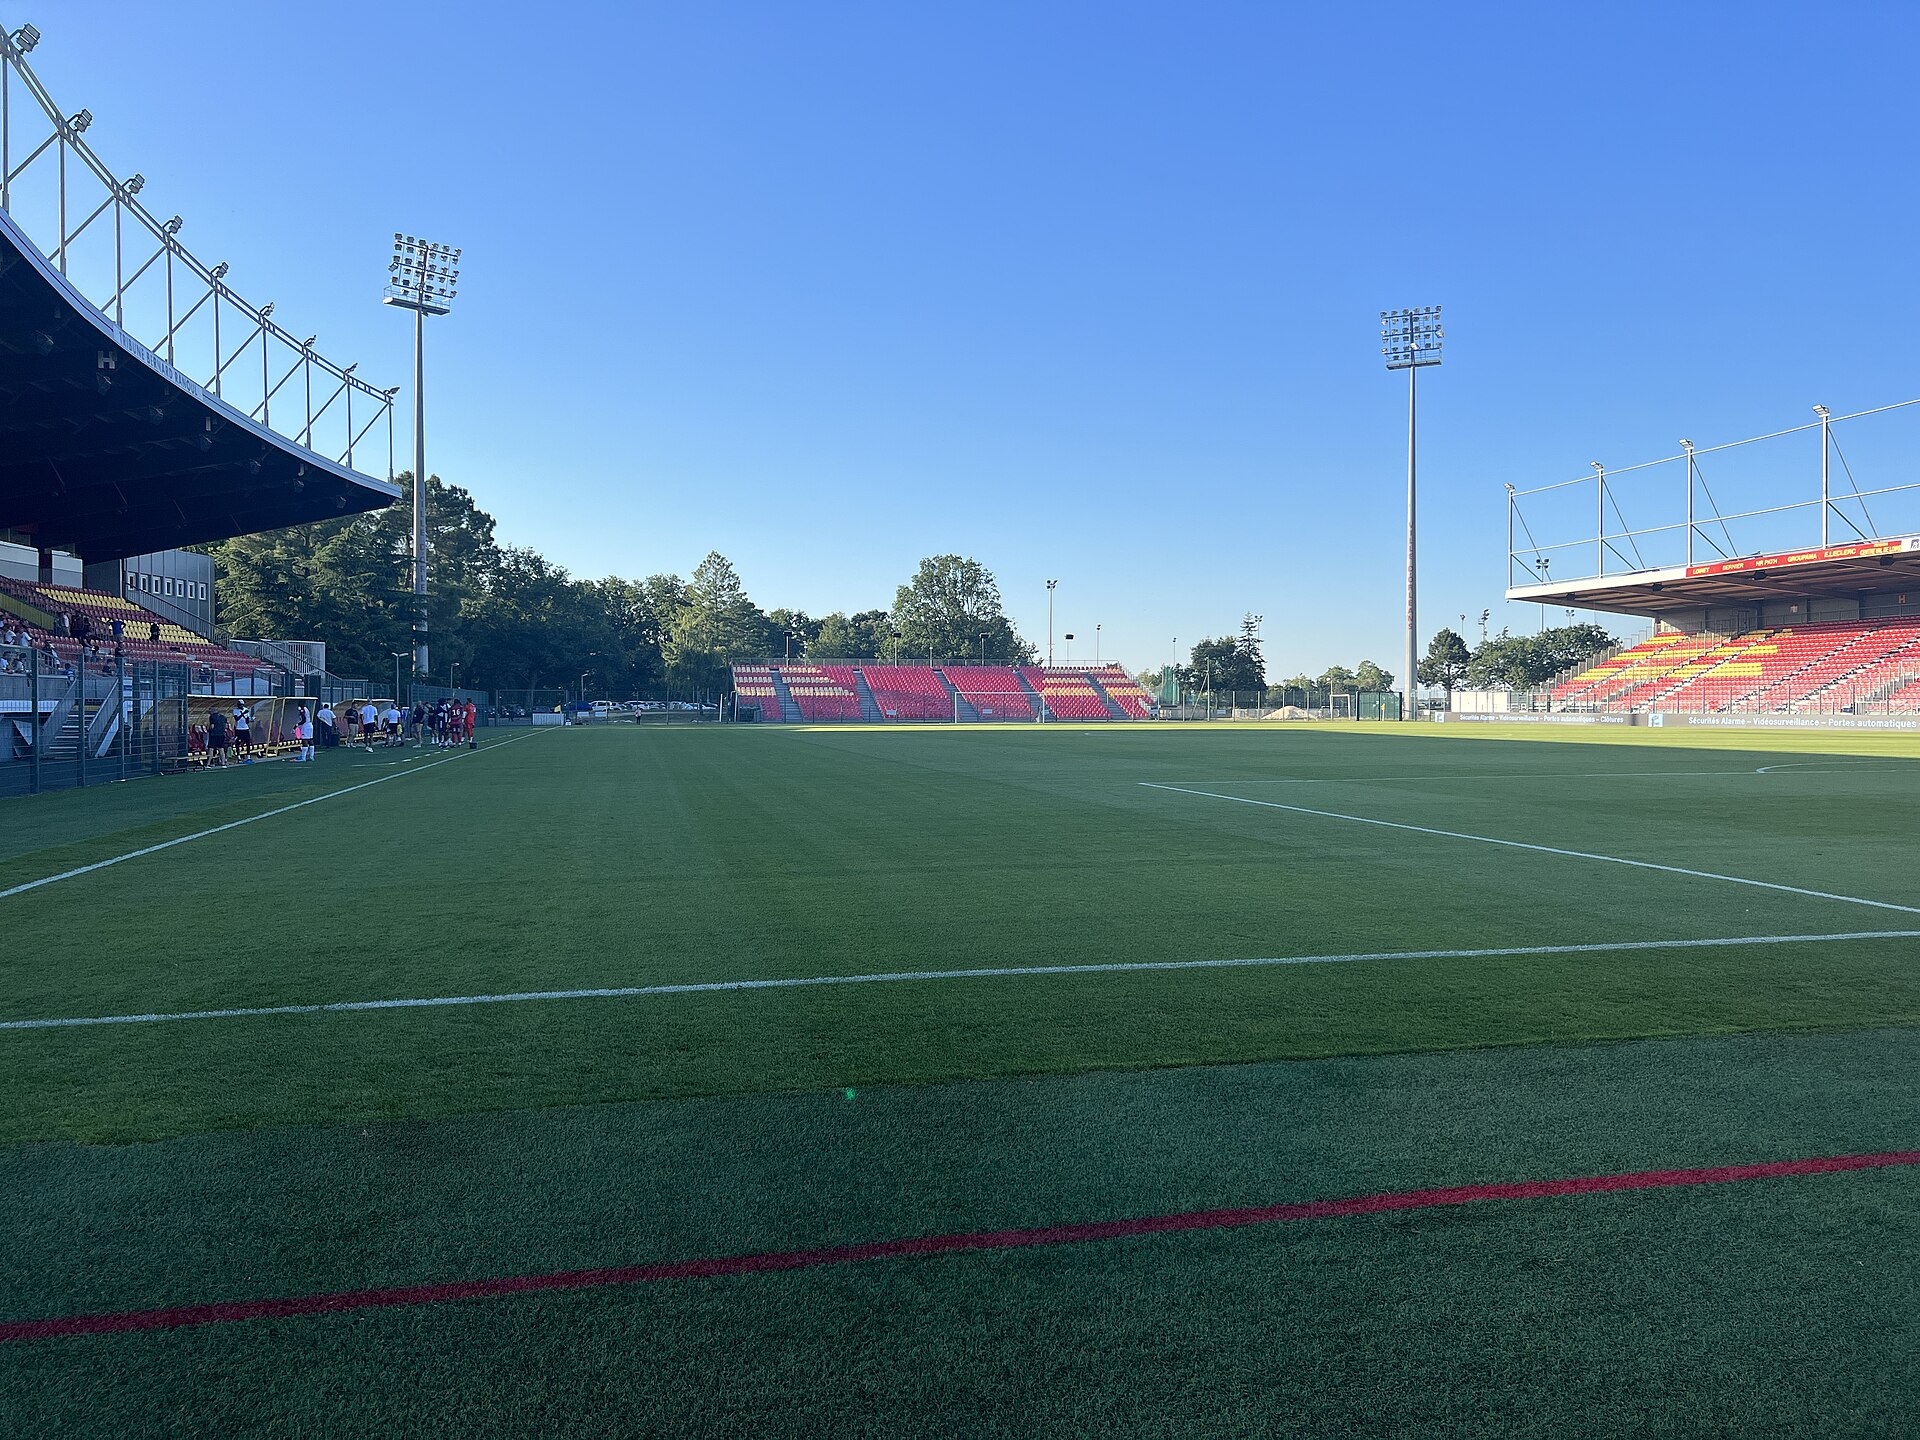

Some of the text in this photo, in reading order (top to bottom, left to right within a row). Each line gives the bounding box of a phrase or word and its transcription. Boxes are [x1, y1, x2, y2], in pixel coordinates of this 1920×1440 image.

[119, 331, 144, 360] TRIBUNE
[146, 352, 173, 379] BERNARD
[1787, 553, 1817, 562] GROUPAMA
[1722, 562, 1744, 571] BERNIER
[451, 708, 461, 717] 16
[1688, 716, 1720, 725] Sécurités
[1720, 717, 1746, 725] Alarme
[1752, 717, 1820, 726] Vidéosurveillance
[1828, 718, 1855, 727] Portes
[1857, 719, 1918, 729] automatiques
